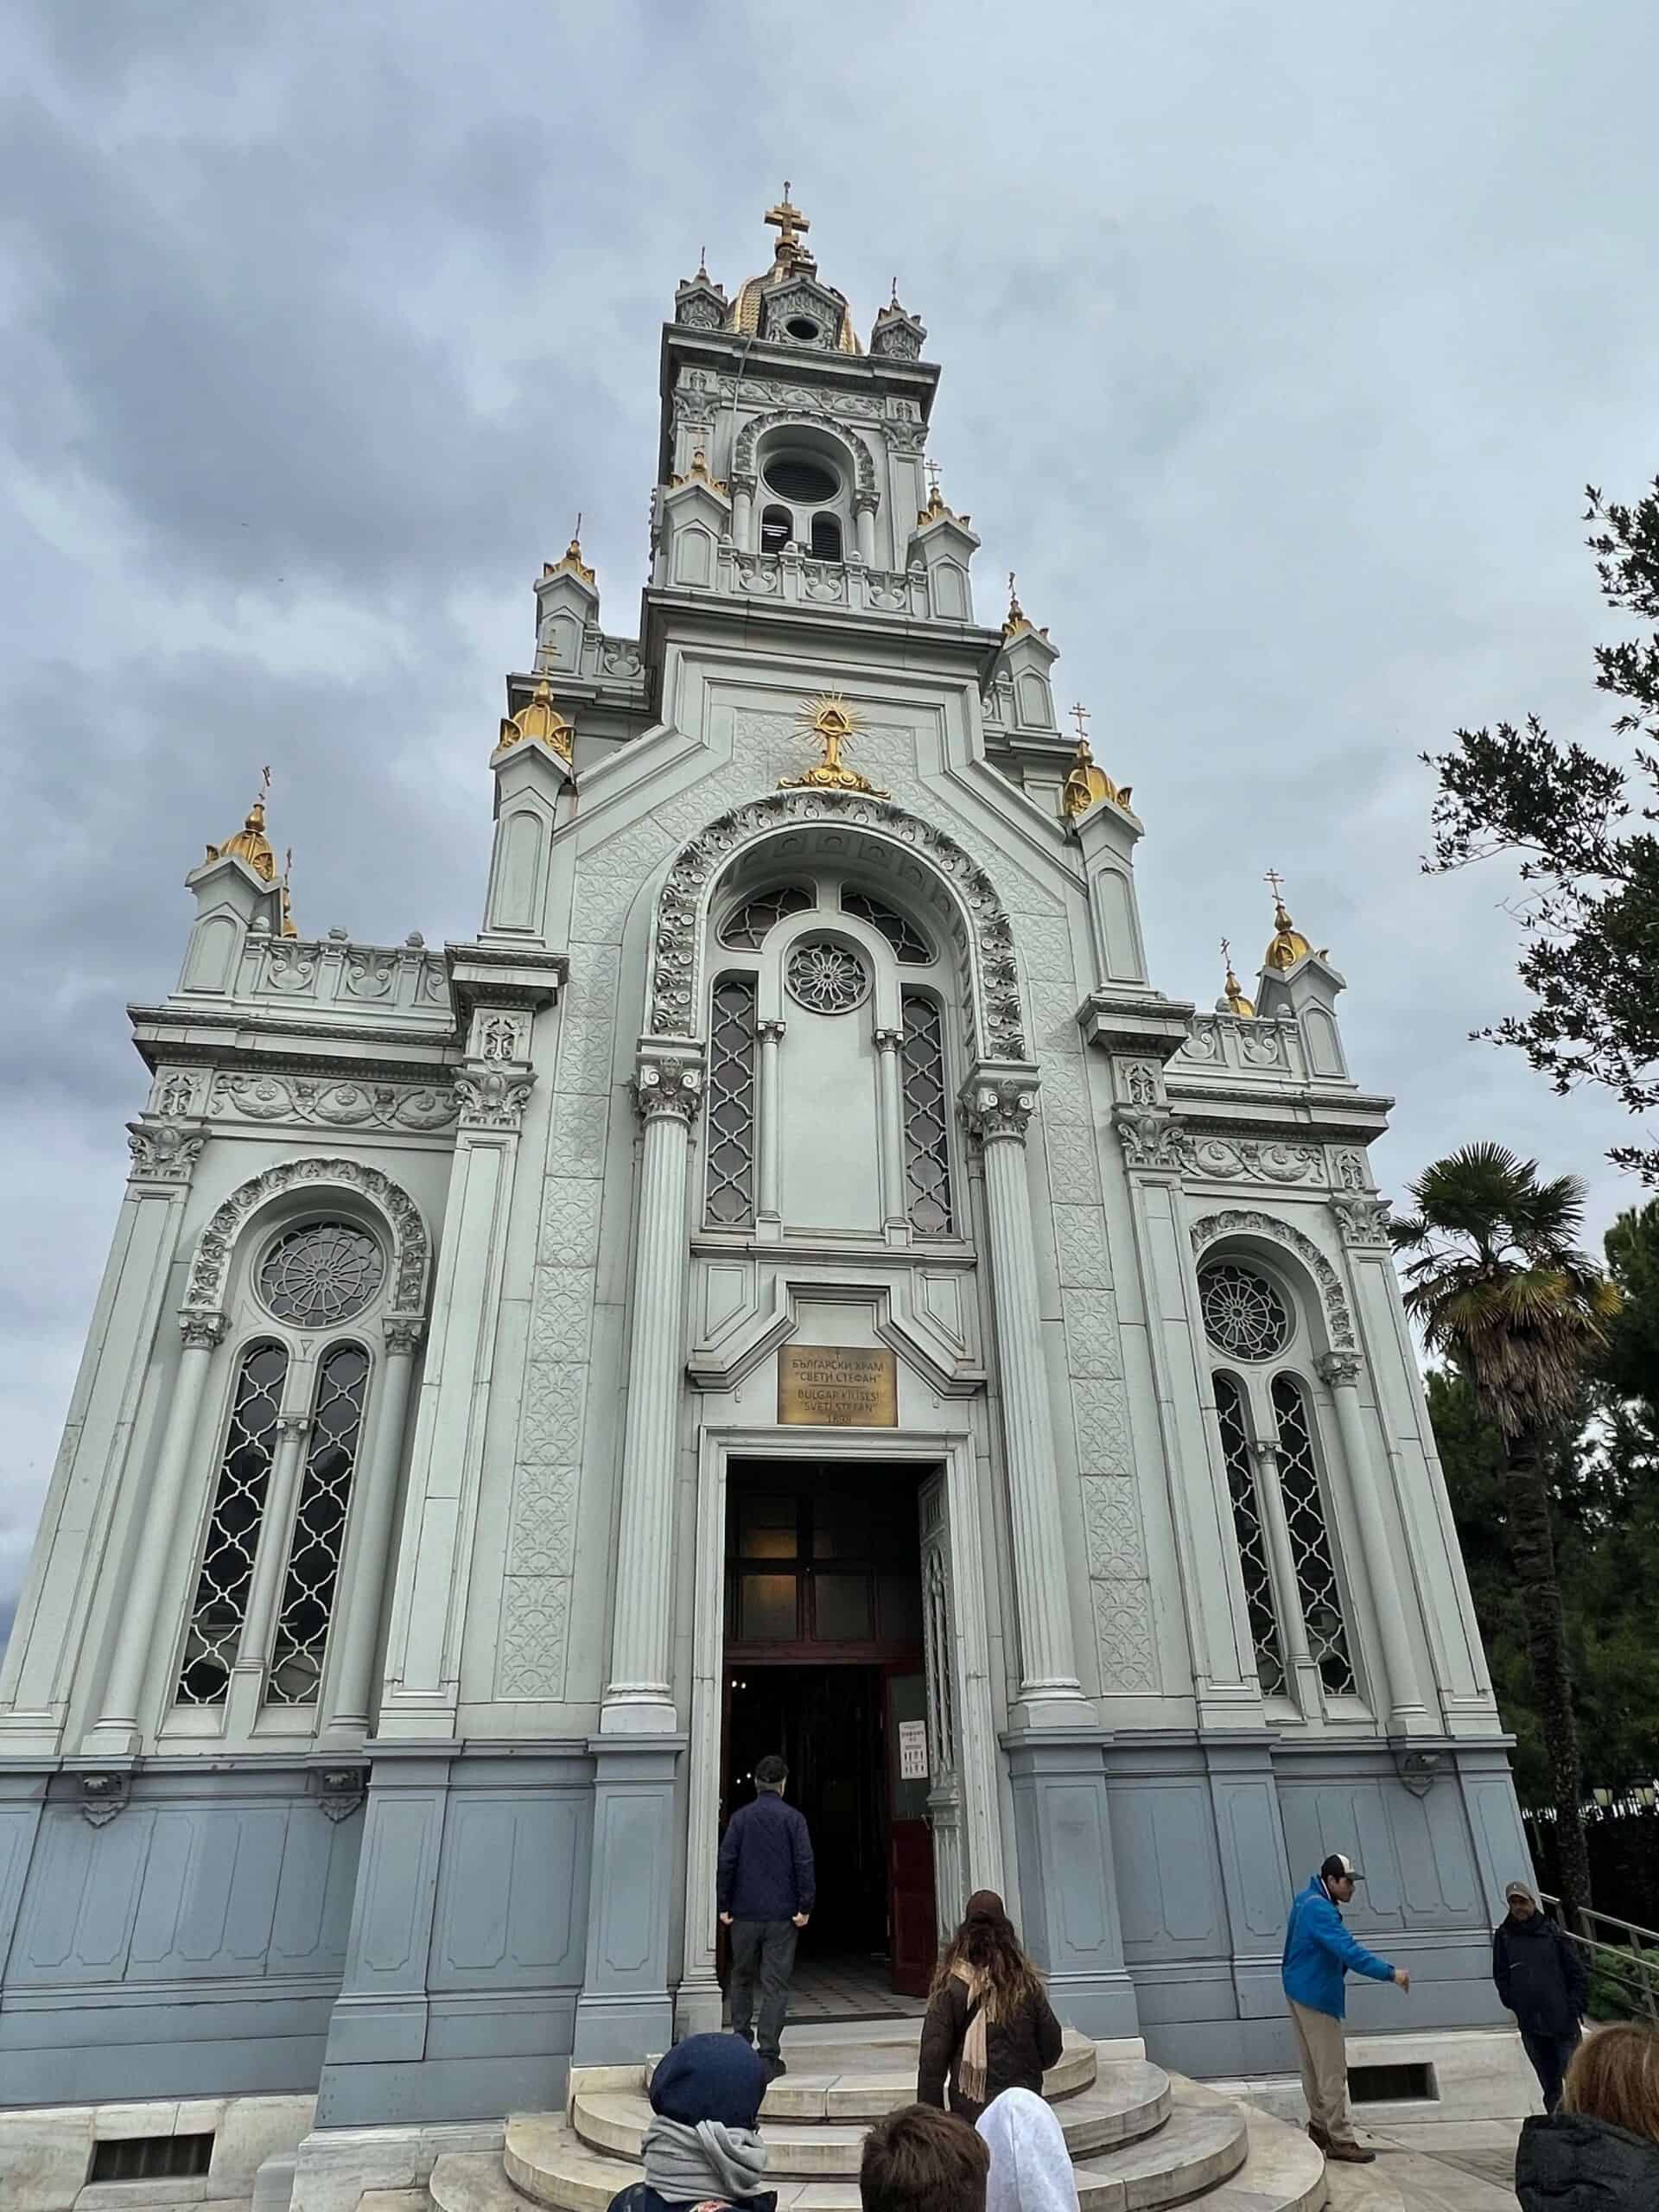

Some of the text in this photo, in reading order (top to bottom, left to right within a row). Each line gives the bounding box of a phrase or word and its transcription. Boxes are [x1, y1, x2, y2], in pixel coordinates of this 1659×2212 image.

[791, 1358, 885, 1371] БЪЛГАРСКИ ХРАМ
[798, 1389, 838, 1400] BULGAR
